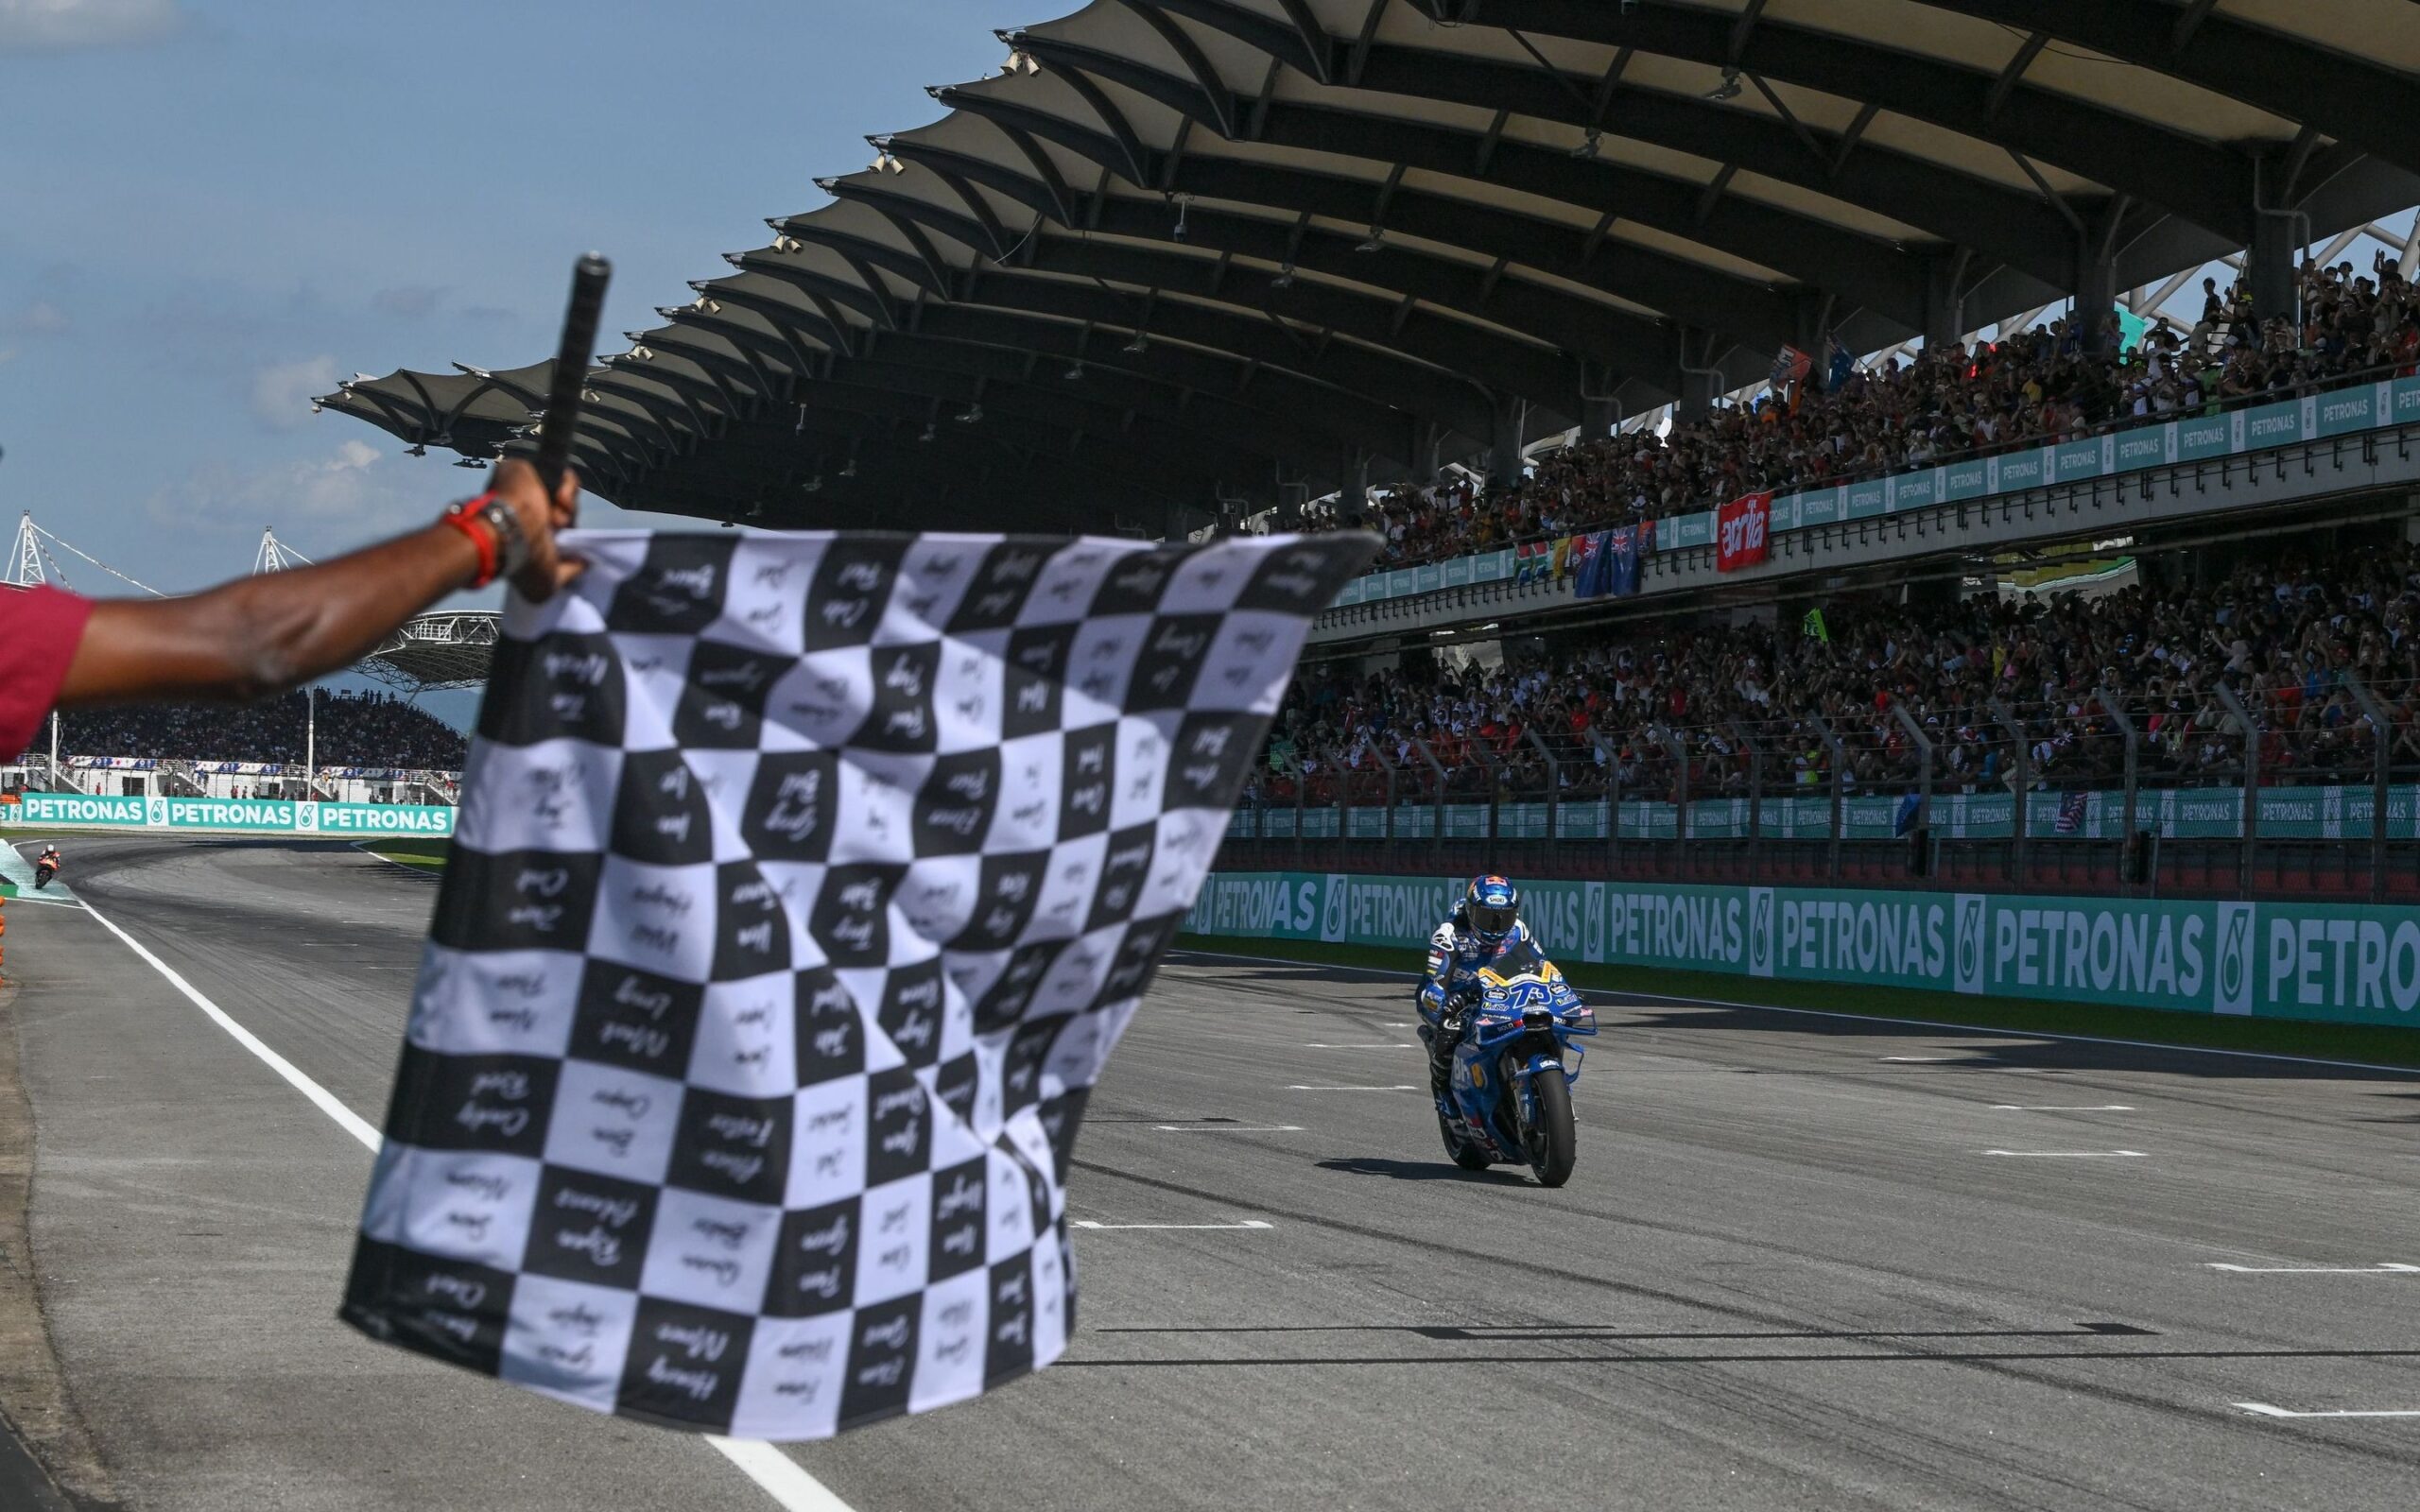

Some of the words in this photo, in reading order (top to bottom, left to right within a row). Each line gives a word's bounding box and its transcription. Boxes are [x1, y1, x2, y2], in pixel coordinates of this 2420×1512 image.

[2324, 399, 2368, 422] PETRONAS
[2252, 414, 2295, 436] PETRONAS
[2184, 427, 2224, 448] PETRONAS
[2120, 438, 2159, 459] PETRONAS
[2003, 460, 2038, 481] PETRONAS
[2060, 450, 2096, 470] PETRONAS
[1899, 481, 1930, 499] PETRONAS
[1950, 471, 1982, 490] PETRONAS
[1805, 499, 1833, 515] PETRONAS
[1852, 490, 1881, 507] PETRONAS
[26, 799, 142, 821] PETRONAS
[172, 803, 291, 826] PETRONAS
[323, 807, 447, 831] PETRONAS
[1853, 810, 1888, 825] PETRONAS
[1972, 807, 2011, 824] PETRONAS
[2183, 804, 2229, 821] PETRONAS
[2263, 803, 2314, 821] PETRONAS
[1215, 879, 1317, 932] PETRONAS
[1349, 883, 1443, 940] PETRONAS
[1612, 884, 1741, 964] PETRONAS
[1782, 900, 1945, 979] PETRONAS
[1995, 908, 2204, 998] PETRONAS
[2270, 918, 2420, 1012] PETRO
